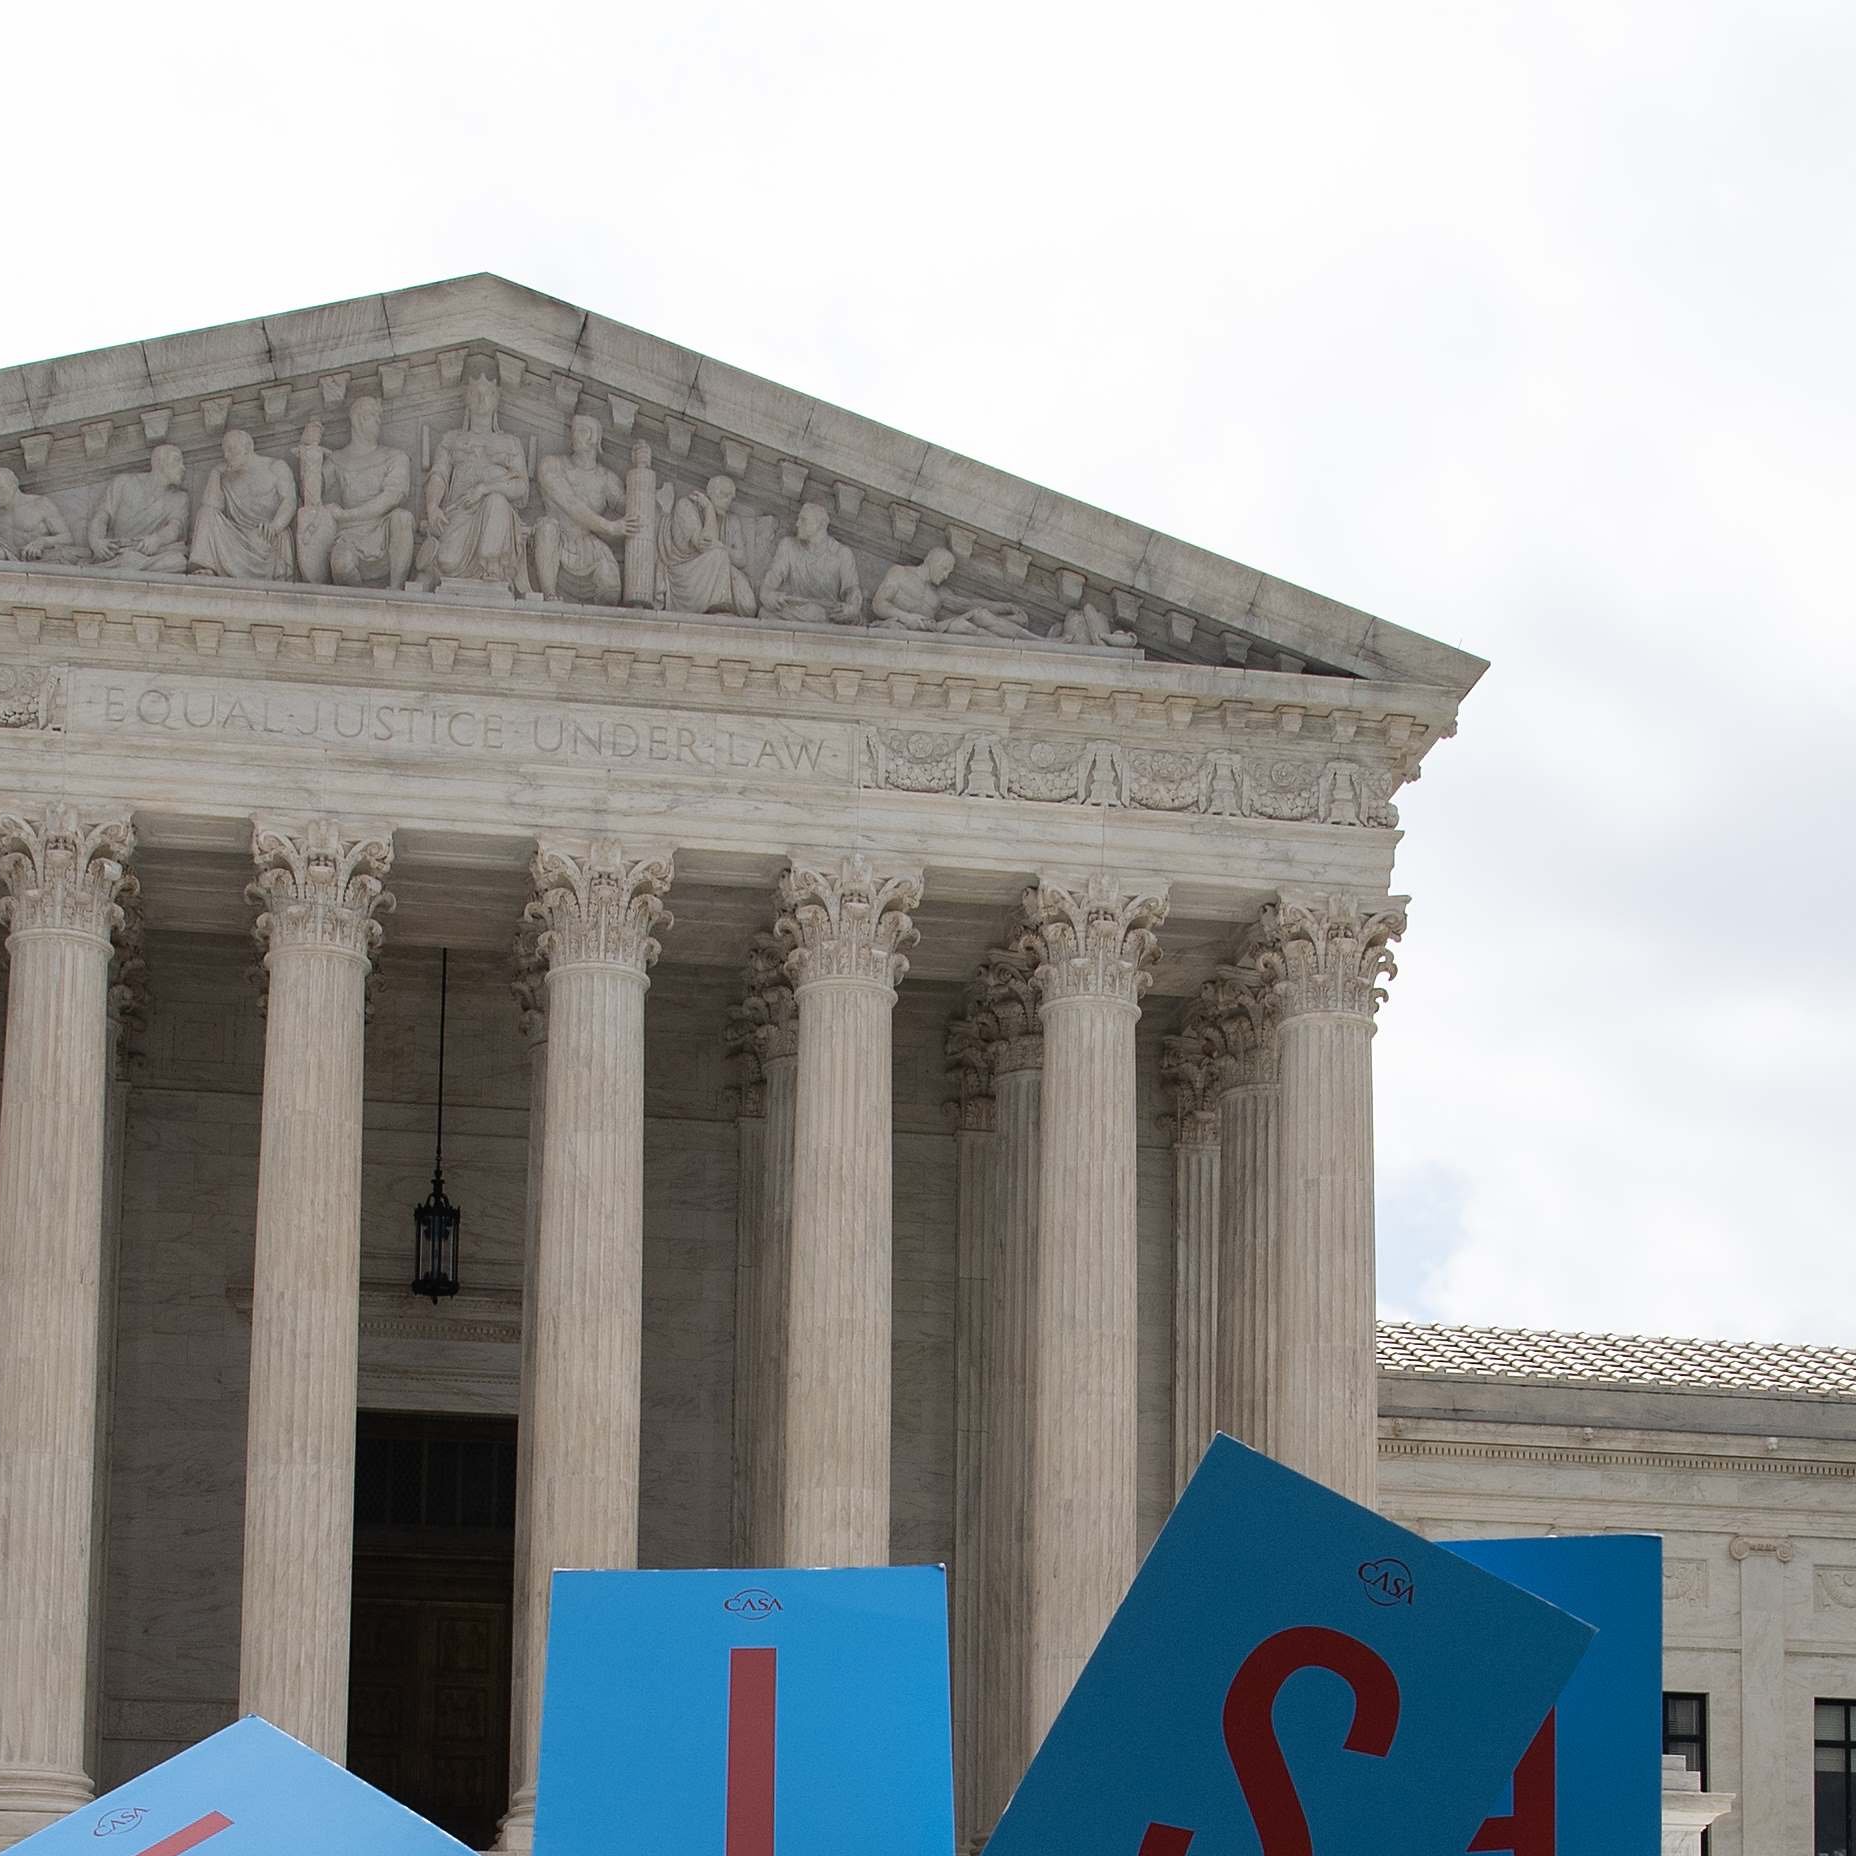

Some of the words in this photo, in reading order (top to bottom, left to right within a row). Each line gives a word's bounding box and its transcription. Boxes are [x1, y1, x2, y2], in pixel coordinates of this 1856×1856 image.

[102, 686, 284, 733] EQUAL
[296, 697, 505, 749] JUSTICE
[532, 714, 711, 766] UNDER
[727, 730, 826, 771] LAW
